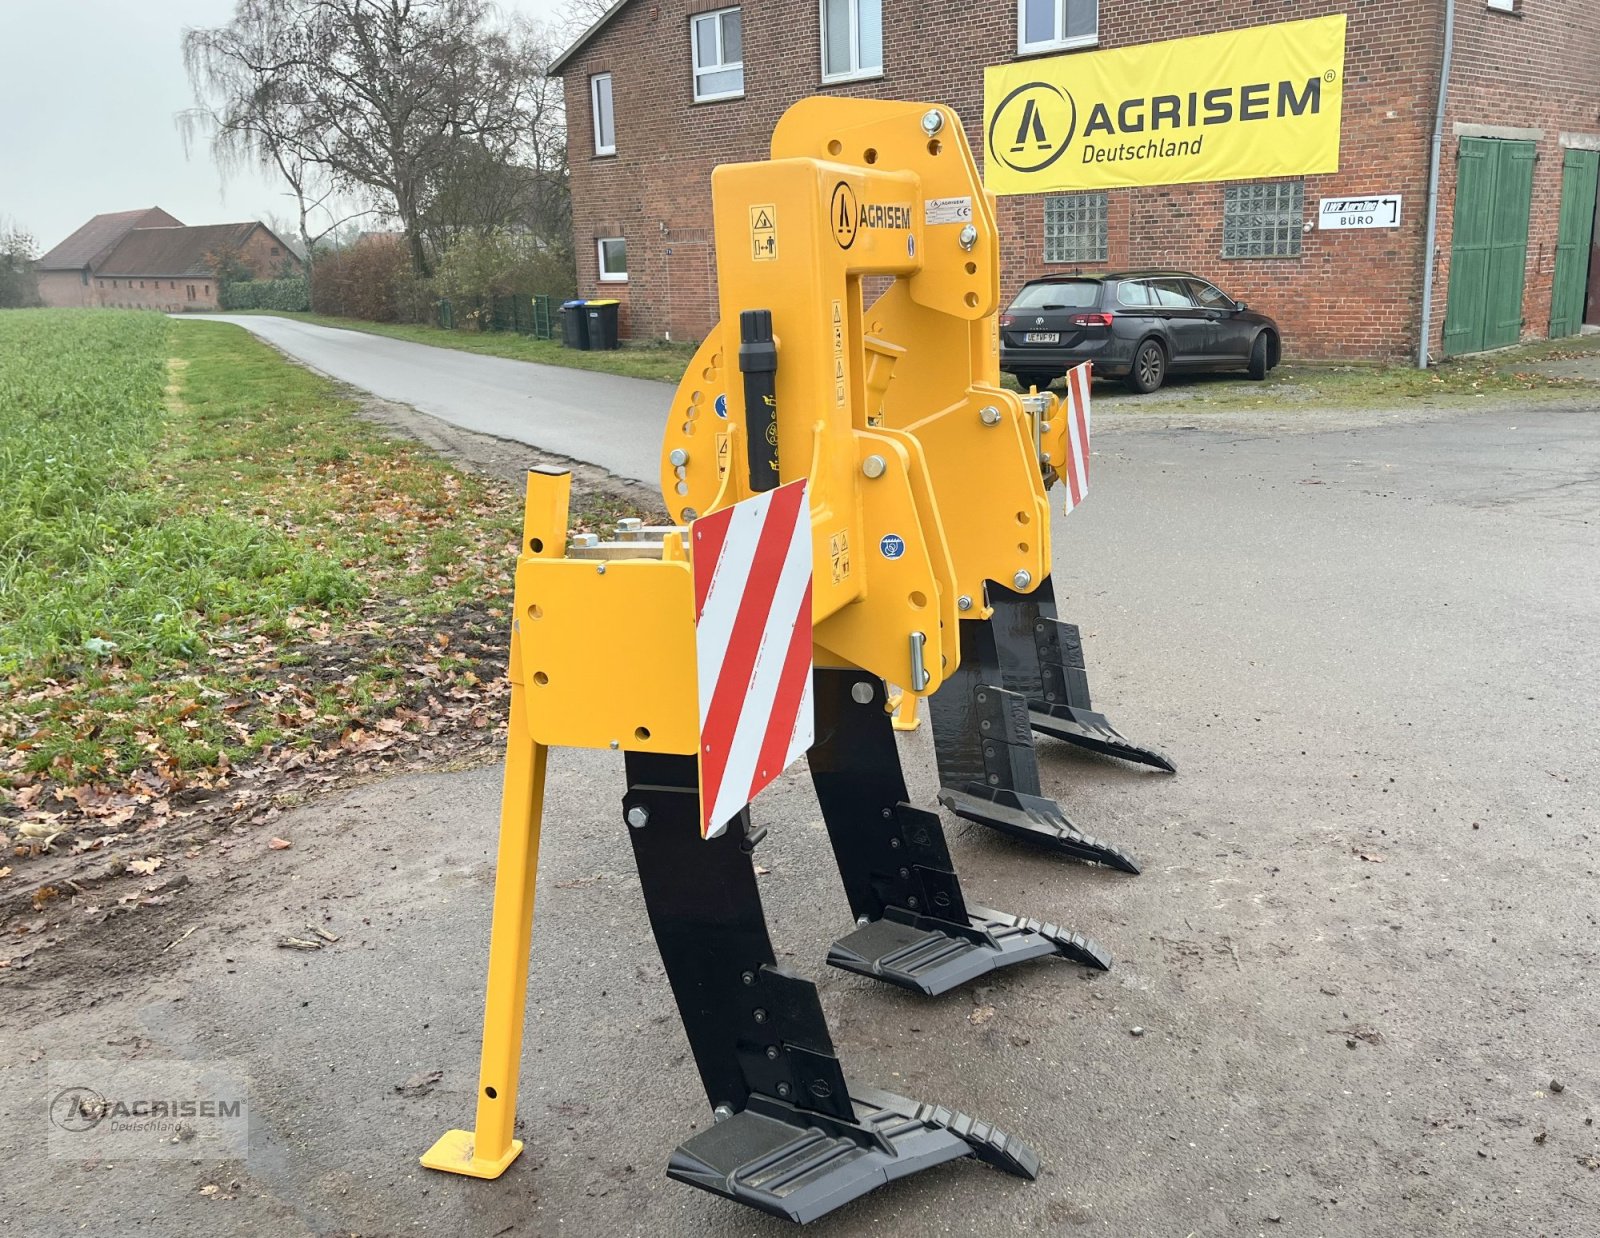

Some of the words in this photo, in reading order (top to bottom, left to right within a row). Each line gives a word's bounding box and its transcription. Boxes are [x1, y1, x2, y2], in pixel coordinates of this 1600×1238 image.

[1083, 76, 1321, 137] AGRISEM
[1082, 135, 1203, 164] Deutschland
[859, 203, 911, 229] AGRISEM
[1340, 215, 1374, 225] BÜRO
